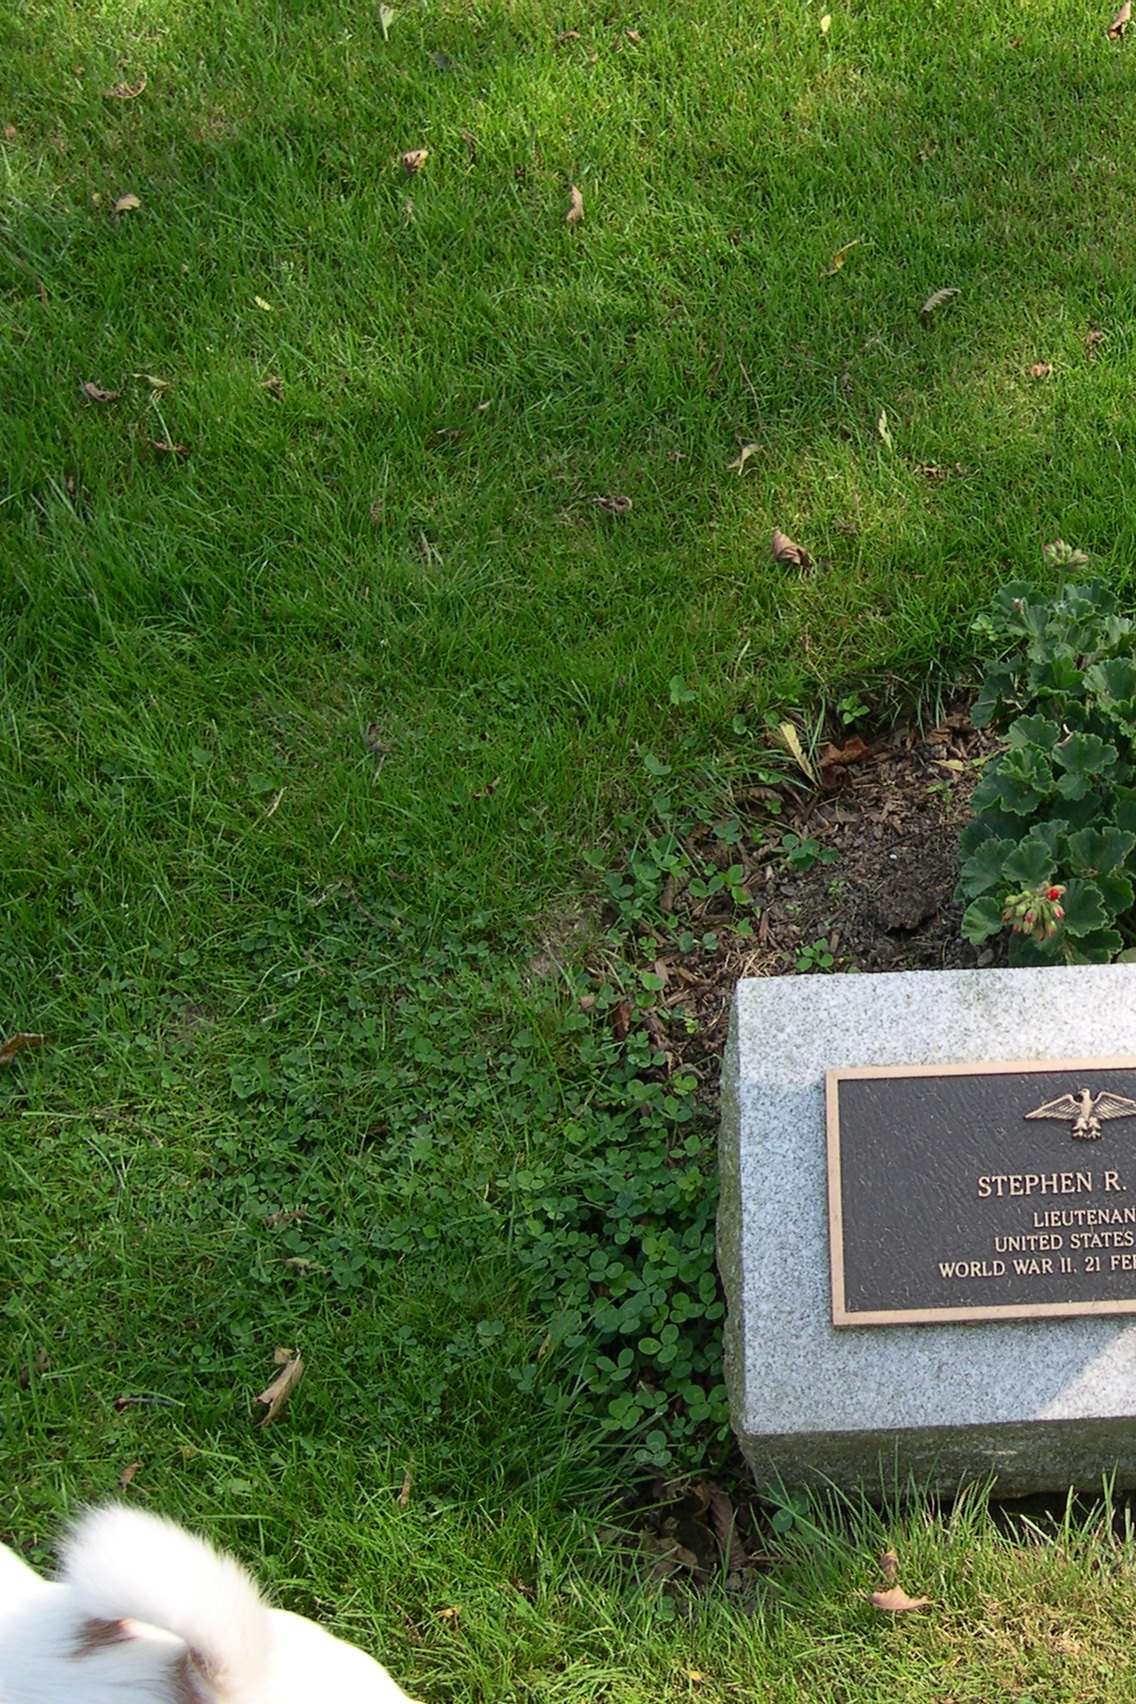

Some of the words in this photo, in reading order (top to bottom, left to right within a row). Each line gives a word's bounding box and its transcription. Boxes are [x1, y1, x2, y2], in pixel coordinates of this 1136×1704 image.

[977, 1171, 1093, 1198] STEPHEN
[1103, 1170, 1128, 1192] R.
[995, 1234, 1064, 1252] UNITED
[1070, 1230, 1134, 1249] STATES
[938, 1259, 1006, 1278] WORLD
[1012, 1258, 1053, 1276] WAR
[1085, 1255, 1101, 1273] 21
